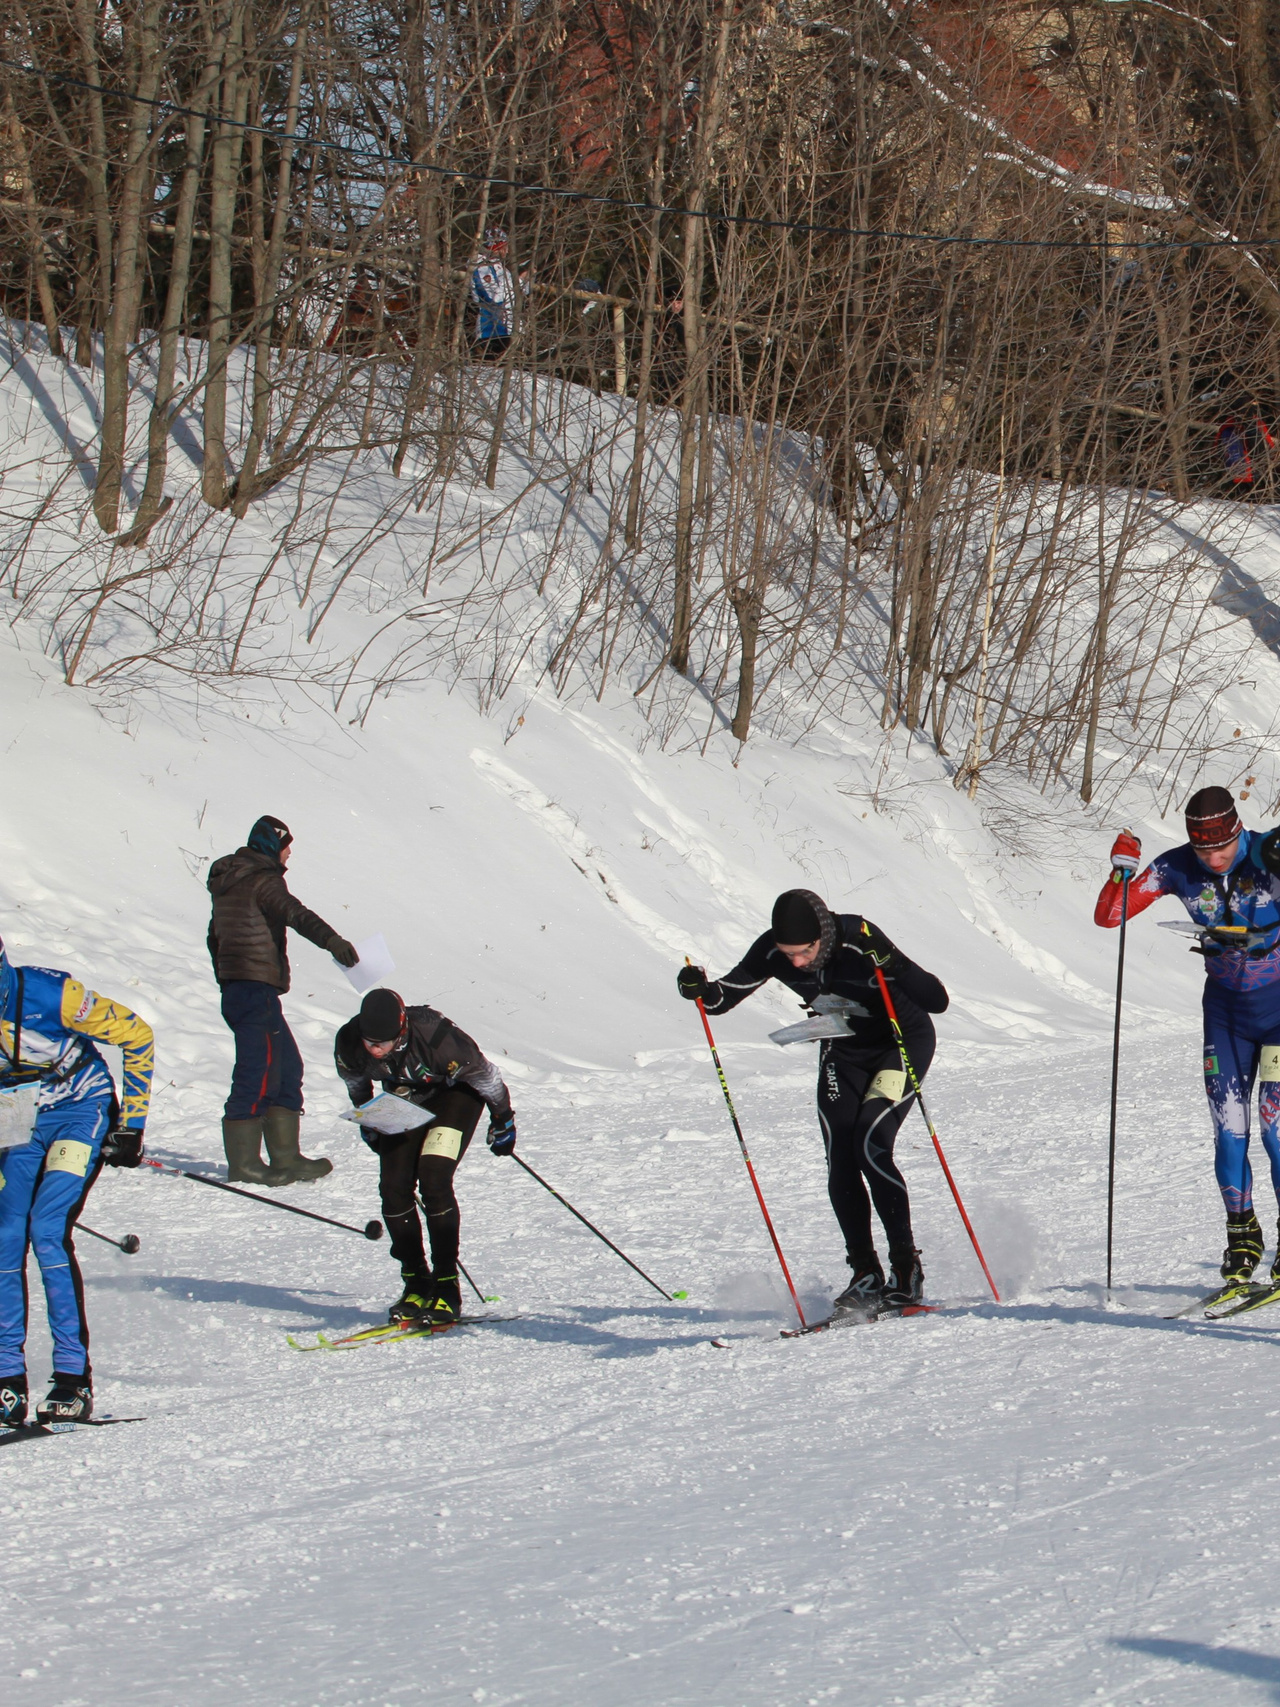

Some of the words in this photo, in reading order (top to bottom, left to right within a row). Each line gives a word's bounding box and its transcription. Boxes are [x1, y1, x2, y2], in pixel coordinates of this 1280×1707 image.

[1272, 1055, 1278, 1064] 4
[826, 1062, 840, 1092] CRAFT
[876, 1076, 882, 1085] 5
[436, 1132, 442, 1141] 7
[59, 1147, 67, 1156] 6
